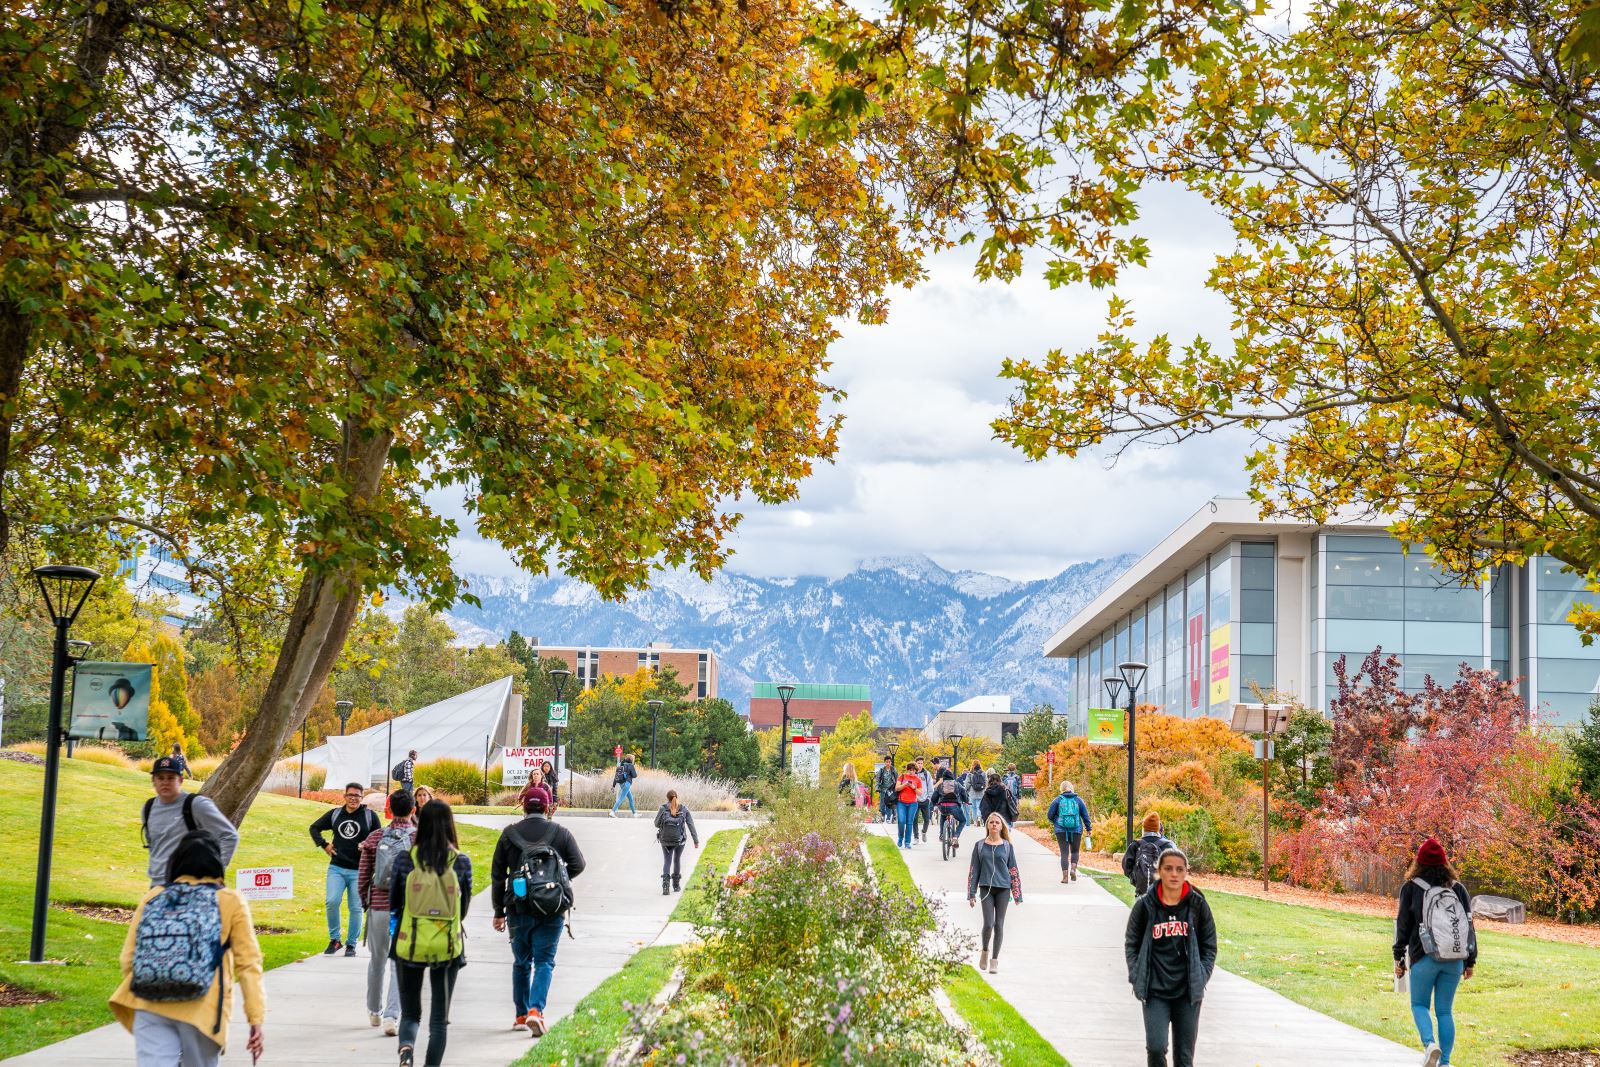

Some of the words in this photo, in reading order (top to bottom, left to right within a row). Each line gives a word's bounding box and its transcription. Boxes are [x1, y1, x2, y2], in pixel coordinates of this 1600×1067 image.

[506, 748, 525, 757] LAW
[528, 748, 562, 756] SCHOO
[524, 759, 544, 767] FAIR
[1450, 916, 1461, 953] Reebok
